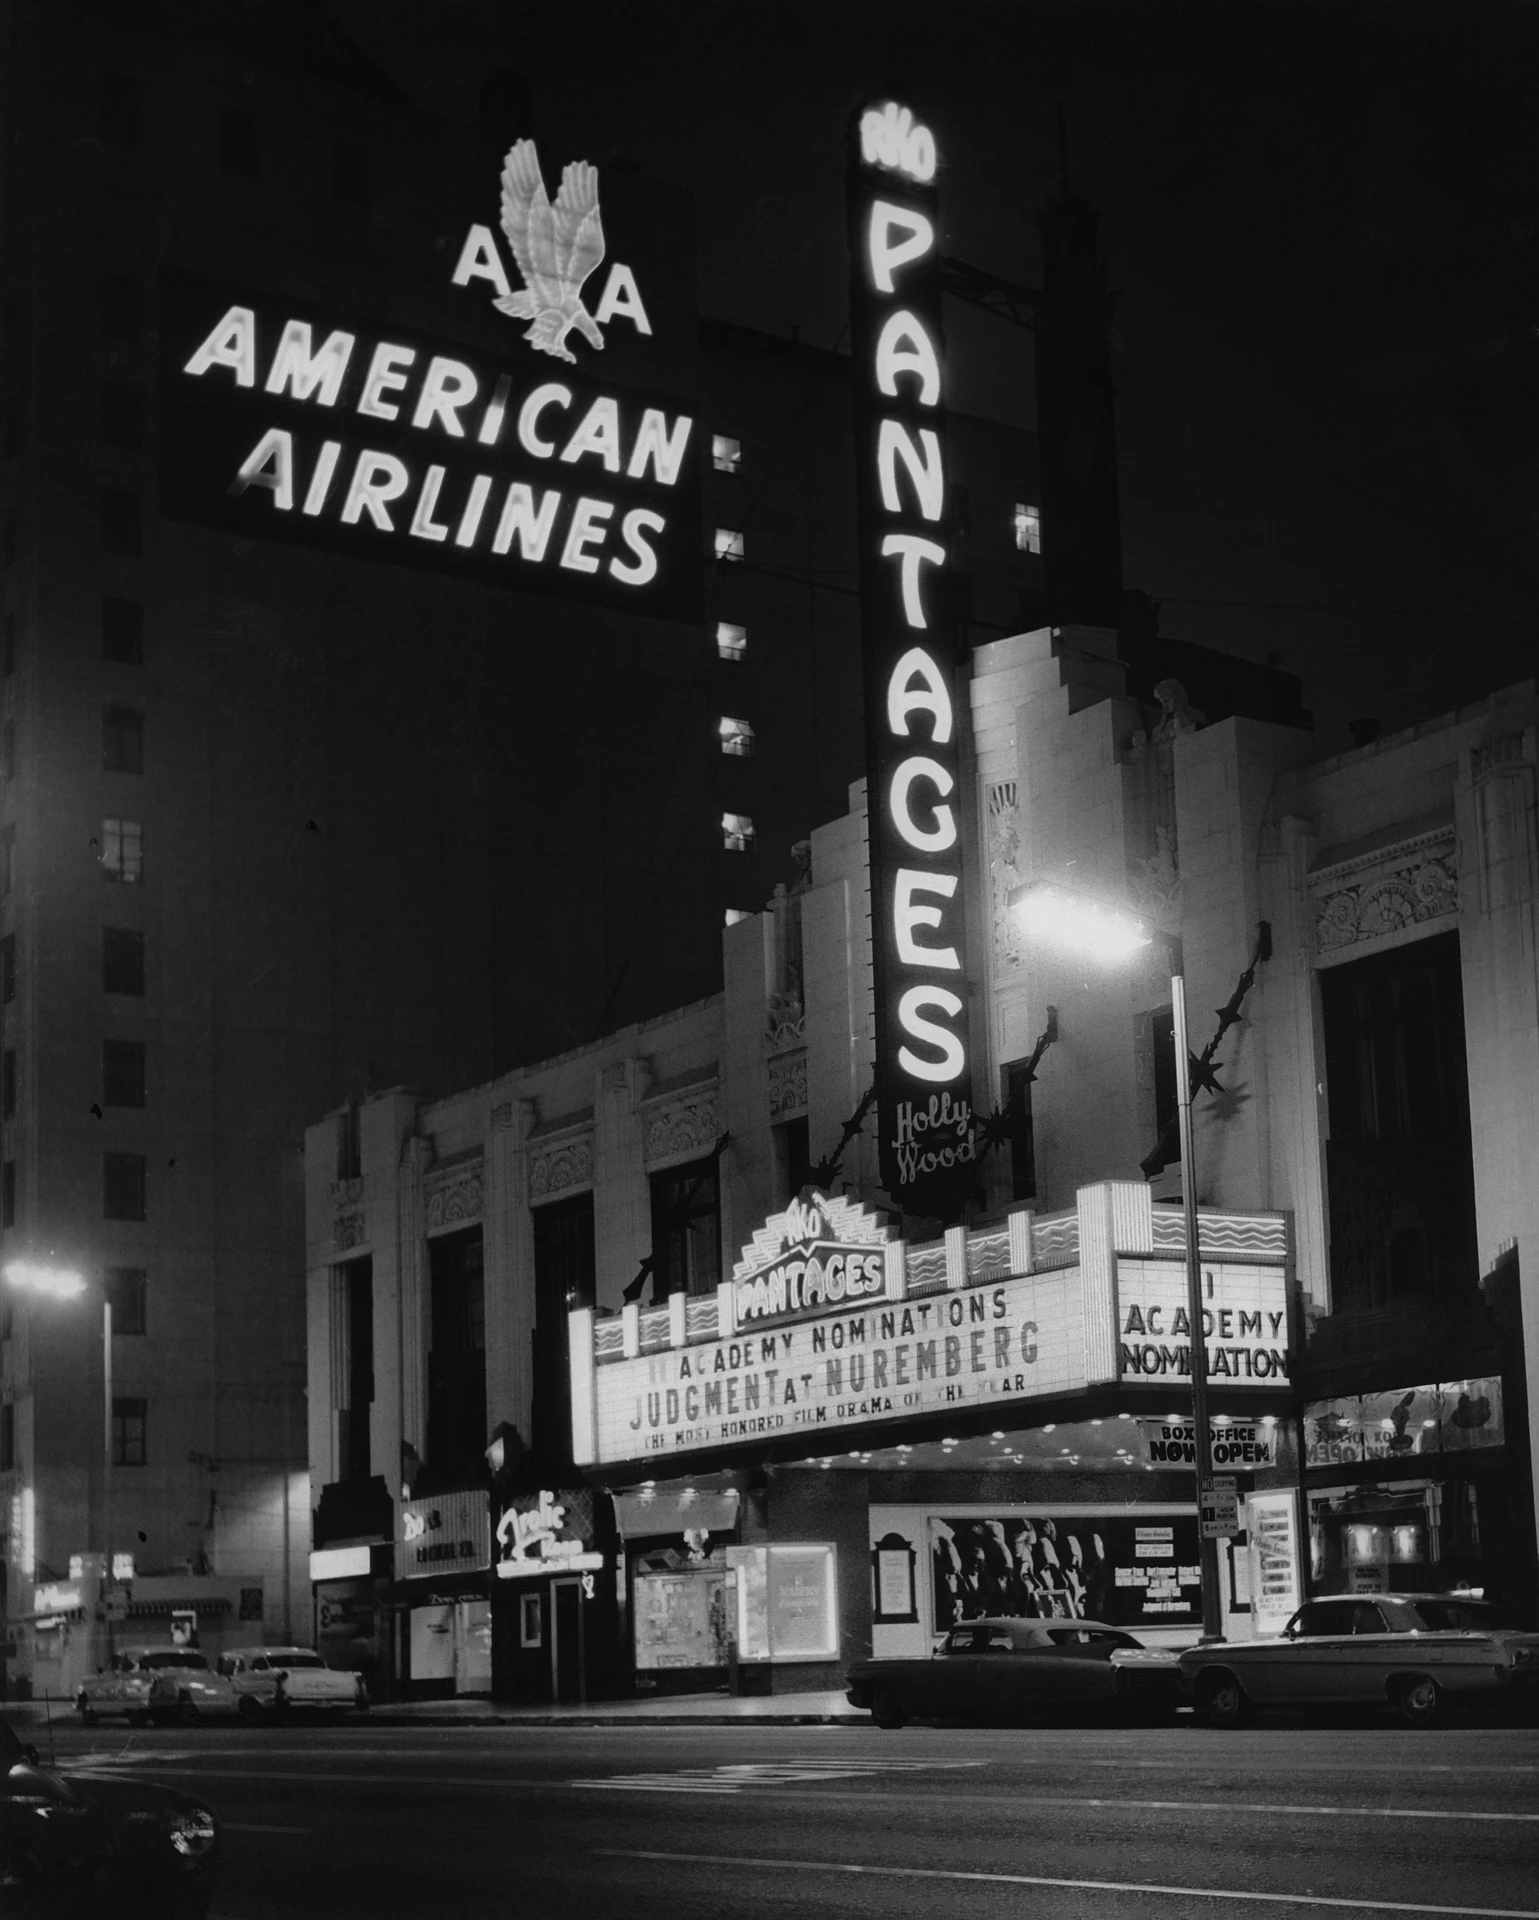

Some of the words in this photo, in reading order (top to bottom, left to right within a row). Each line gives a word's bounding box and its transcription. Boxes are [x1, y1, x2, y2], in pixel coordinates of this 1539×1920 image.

[451, 223, 512, 296] A
[594, 262, 653, 335] A
[183, 305, 693, 485] AMERICAN
[226, 427, 666, 586] AIRLINES
[869, 200, 964, 1083] PANTAGES
[896, 1091, 971, 1143] Holly
[737, 1254, 881, 1321] PANTAGES
[680, 1332, 793, 1379] ACADEMY
[812, 1288, 1006, 1353] NOMINATIONS
[1124, 1304, 1283, 1339] ACADEMY
[629, 1368, 779, 1430] JUDGMENT
[784, 1373, 813, 1404] AT
[826, 1321, 1039, 1396] NUREMBERG
[1120, 1342, 1289, 1378] NOMIATION
[721, 1414, 784, 1437] HONORED
[794, 1406, 827, 1424] FILM
[836, 1396, 893, 1417] DRAMA
[979, 1374, 1025, 1394] AR
[1162, 1426, 1195, 1440] BOX
[1209, 1427, 1255, 1441] OFFICE
[1150, 1441, 1196, 1463] NOW
[1213, 1442, 1270, 1464] OPEN
[1202, 1479, 1213, 1490] NO
